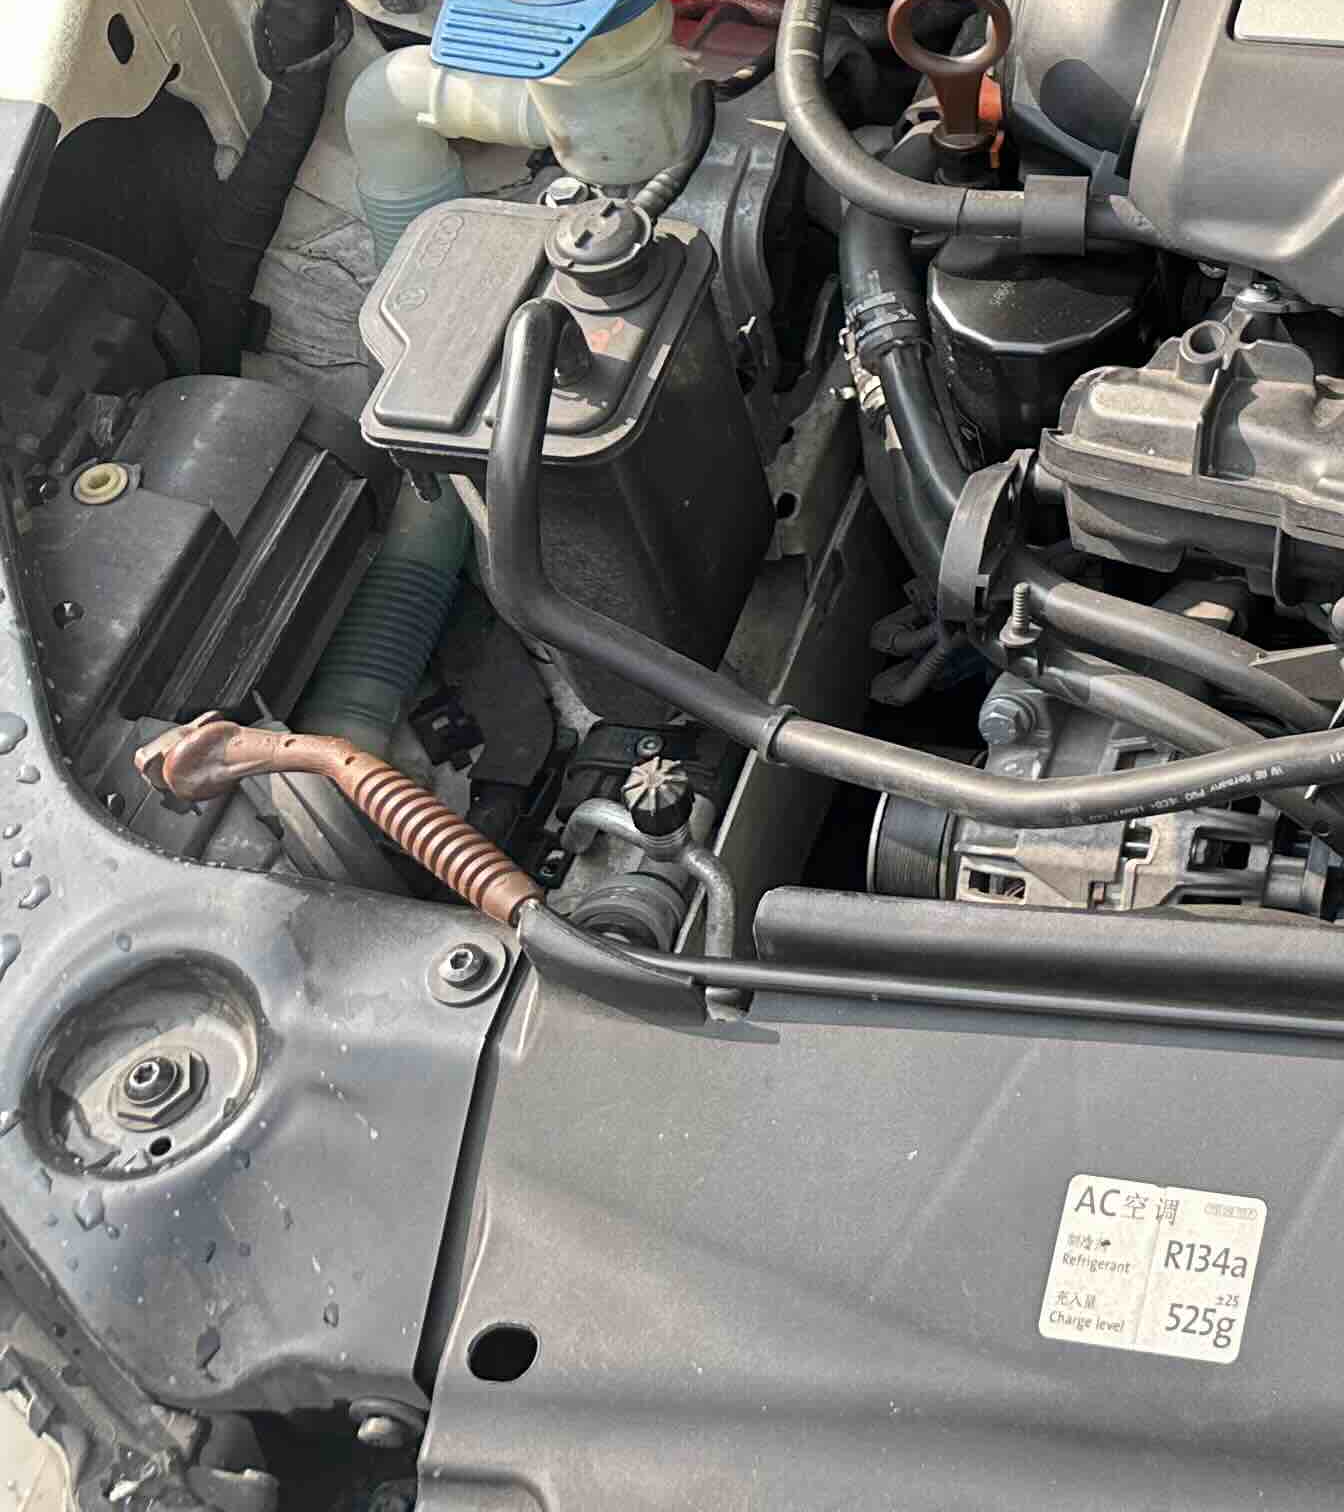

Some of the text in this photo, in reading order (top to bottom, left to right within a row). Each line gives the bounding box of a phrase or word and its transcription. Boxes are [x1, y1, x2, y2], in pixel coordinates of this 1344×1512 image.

[1062, 1252, 1132, 1275] Refrigerant
[1163, 1239, 1249, 1279] R134a
[1049, 1310, 1126, 1334] Charge level
[1165, 1303, 1237, 1349] 525g
